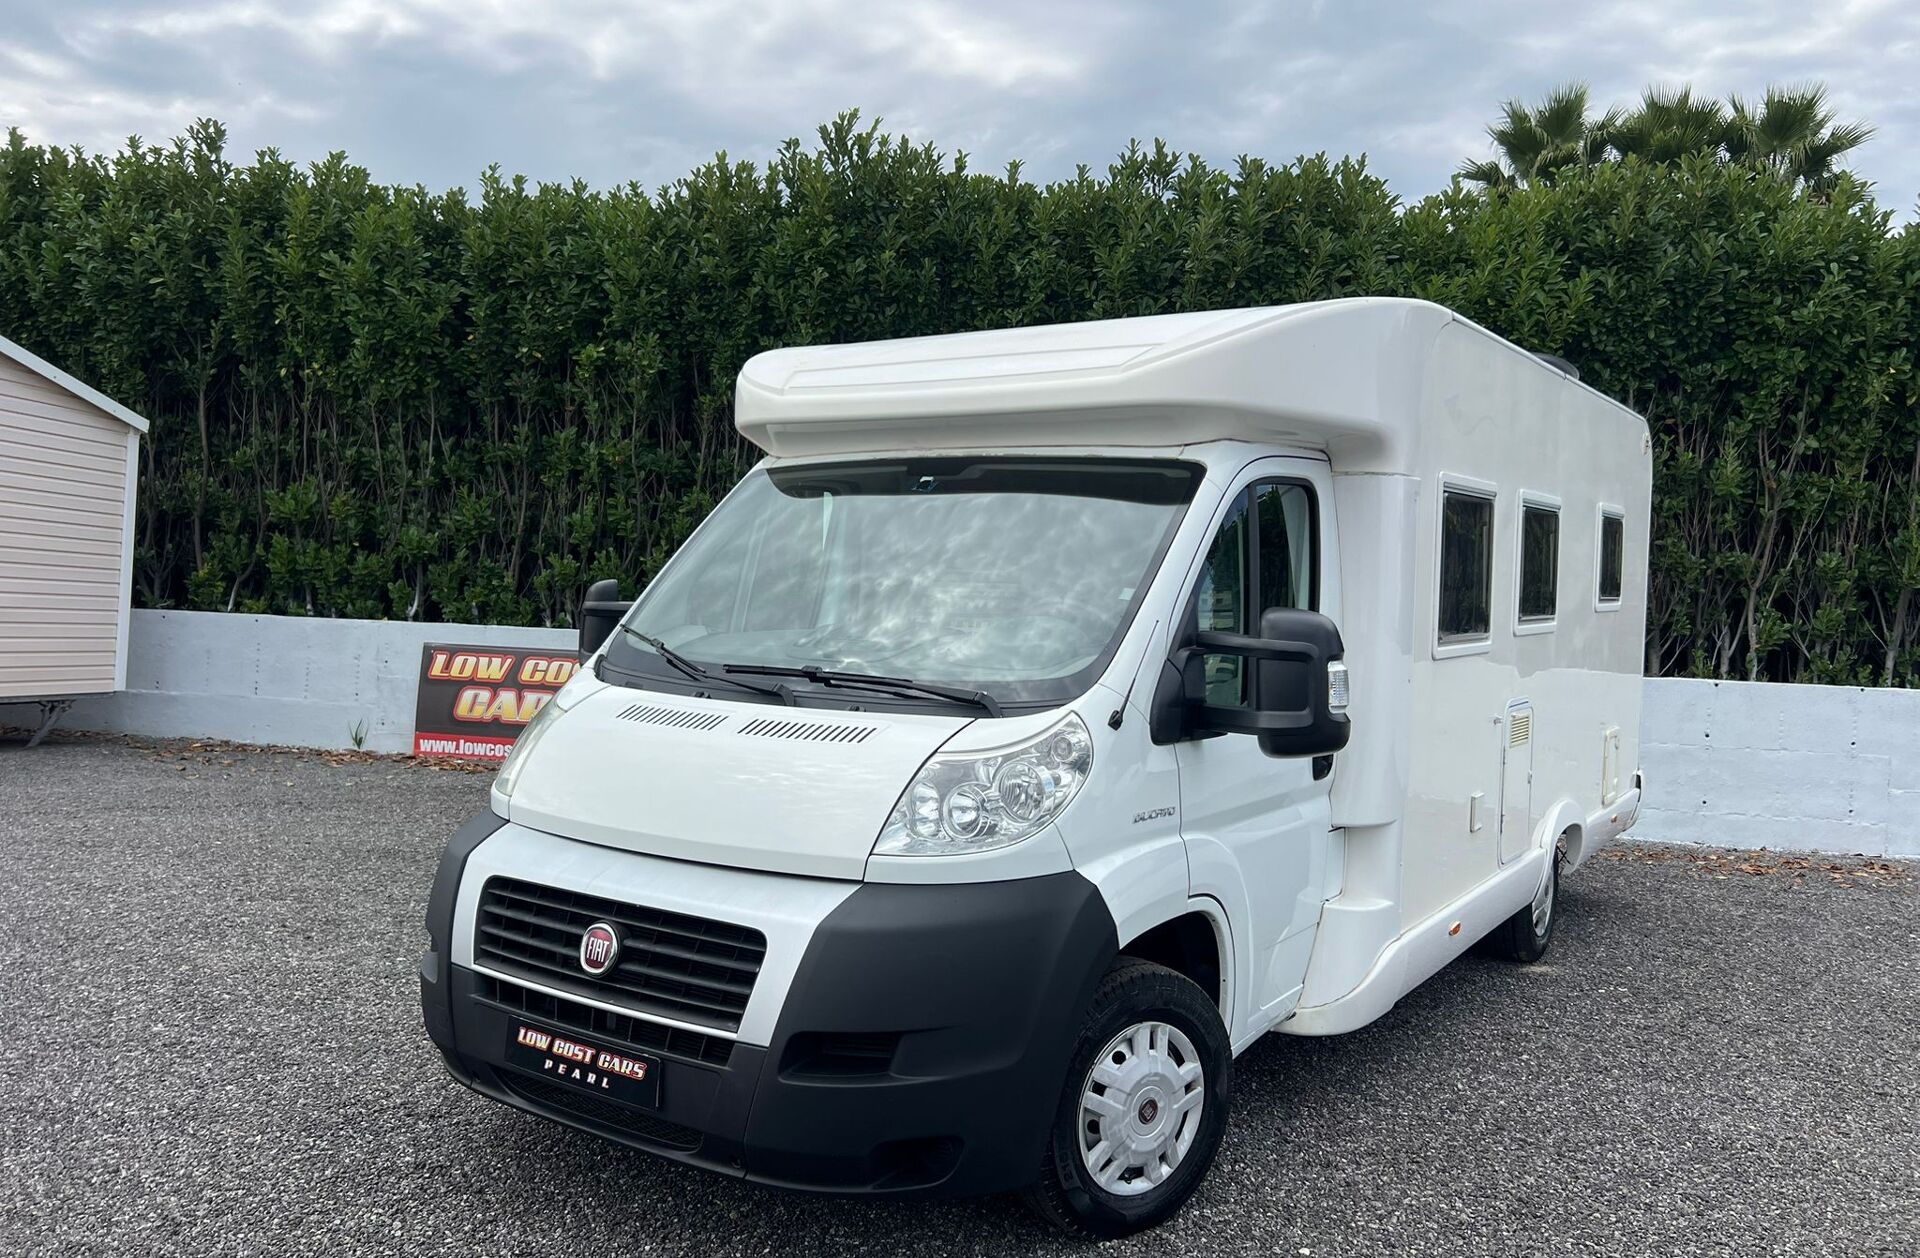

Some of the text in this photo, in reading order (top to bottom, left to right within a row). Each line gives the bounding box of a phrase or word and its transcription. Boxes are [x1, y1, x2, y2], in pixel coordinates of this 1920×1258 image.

[429, 651, 579, 684] LOW CO
[586, 936, 610, 963] FIAT
[517, 1026, 648, 1080] LOW COST CARS
[543, 1058, 610, 1089] PEARL
